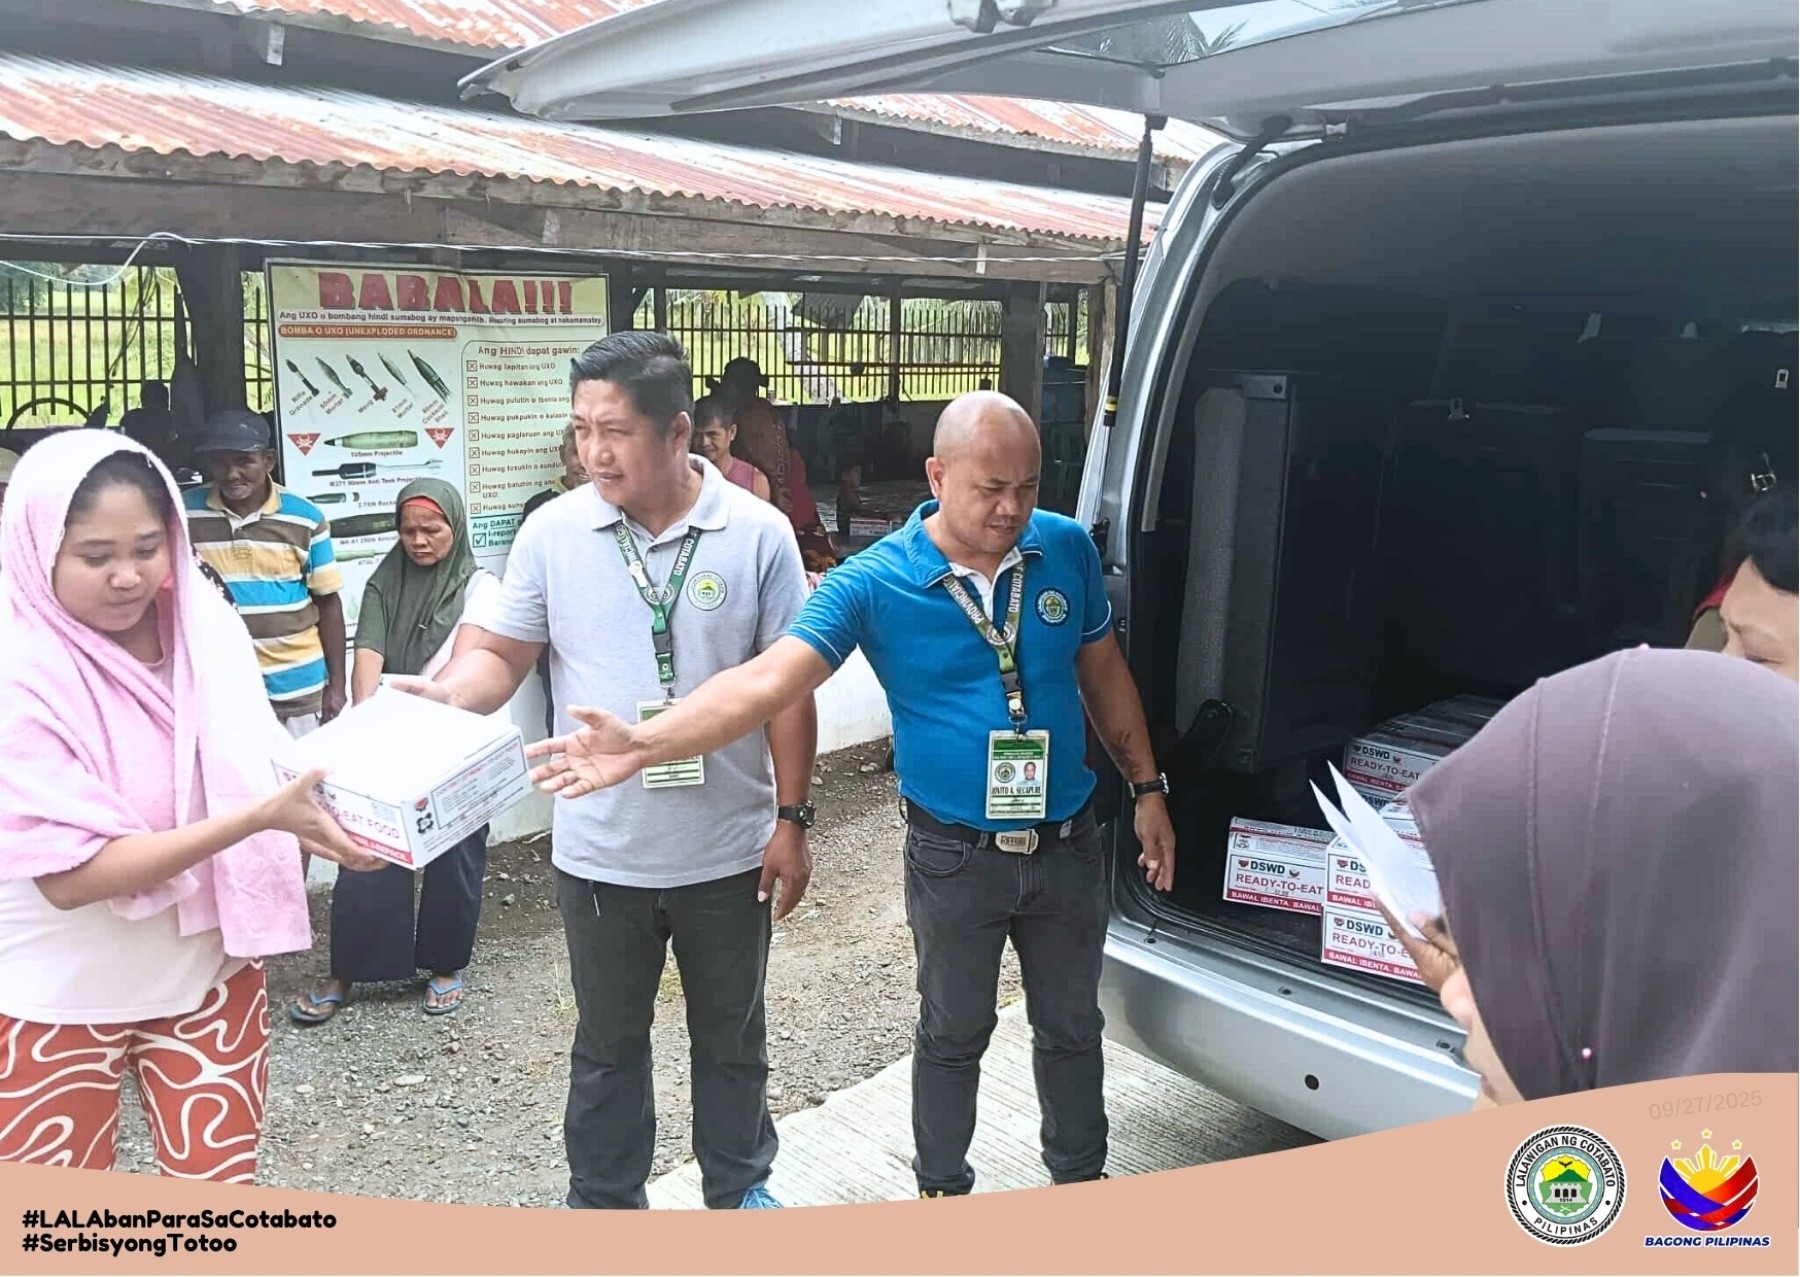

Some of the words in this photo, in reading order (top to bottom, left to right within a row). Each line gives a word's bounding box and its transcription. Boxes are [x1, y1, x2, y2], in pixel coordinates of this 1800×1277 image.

[317, 272, 573, 315] BABALA!!!
[280, 311, 297, 320] Ang
[299, 311, 318, 319] UXO
[328, 311, 367, 321] bombang
[368, 312, 389, 320] hindi
[390, 313, 426, 322] sumabog
[428, 314, 438, 323] ay
[518, 316, 549, 325] sumabog
[550, 316, 557, 324] at
[281, 326, 314, 335] BOMBA
[315, 327, 323, 335] O
[325, 327, 344, 335] UXO
[478, 345, 497, 357] Ang
[500, 346, 525, 355] HINDI
[526, 346, 550, 356] dapat
[552, 346, 580, 356] gawin:
[480, 363, 502, 371] Huwag
[504, 362, 528, 371] lapitan
[541, 362, 556, 370] UXO
[480, 380, 503, 388] Huwag
[504, 379, 536, 387] hawakan
[288, 396, 313, 416] Grenade
[480, 397, 505, 405] Huwag
[506, 396, 530, 405] pulutin
[481, 414, 505, 422] Huwag
[506, 414, 538, 422] pukpukin
[481, 432, 506, 440] Huwag
[507, 431, 541, 440] paglaruan
[481, 449, 506, 457] Huwag
[507, 448, 534, 456] hukayin
[482, 466, 506, 474] Huwag
[482, 482, 506, 490] Huwag
[483, 504, 507, 512] Huwag
[472, 522, 488, 531] Ang
[490, 518, 516, 528] DAPAT
[673, 538, 694, 576] COTABATO
[1008, 572, 1024, 613] COTABATO
[948, 579, 985, 625] PROVINCIAL
[1362, 746, 1390, 760] DSWD
[1350, 757, 1420, 780] READY-TO-EAT
[1361, 794, 1387, 806] DSW
[367, 819, 400, 839] FOOD
[1250, 861, 1285, 874] DSWD
[1350, 860, 1367, 872] DS
[1236, 873, 1324, 895] READY-TO-EAT
[1231, 891, 1259, 902] BAWAL
[1292, 901, 1320, 912] BAWAL
[1331, 894, 1361, 906] BAWAL
[1346, 919, 1384, 936] DSWD
[1332, 932, 1409, 958] READY-TO-E
[1328, 952, 1357, 964] BAWAL
[1393, 967, 1422, 979] BAWA
